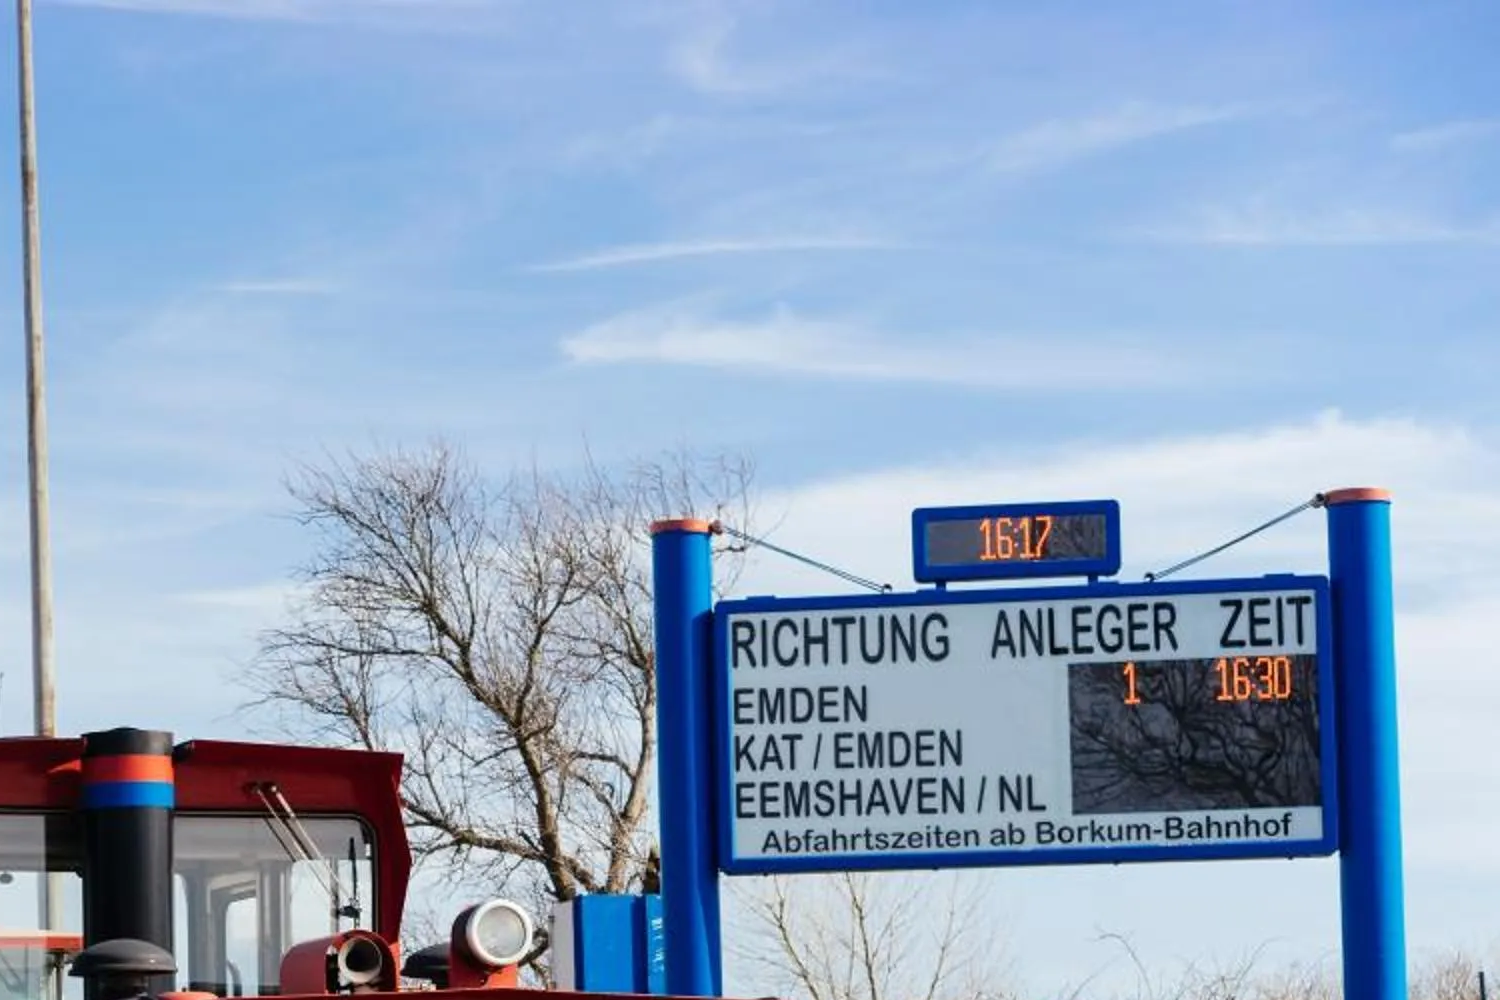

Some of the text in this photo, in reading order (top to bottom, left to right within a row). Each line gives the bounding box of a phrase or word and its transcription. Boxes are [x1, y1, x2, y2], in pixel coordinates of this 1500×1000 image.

[979, 515, 1052, 561] 16:17
[731, 595, 1313, 669] RICHTUNG ANLEGER ZEIT
[1123, 655, 1292, 706] 1 16:30
[733, 685, 868, 725] EMDEN
[734, 733, 803, 772] KAT
[833, 729, 963, 769] EMDEN
[735, 776, 965, 819] EEMSHAVEN
[998, 774, 1047, 813] NL
[761, 812, 1293, 854] Abfahrtszeiten ab Borkum-Bahnhof
